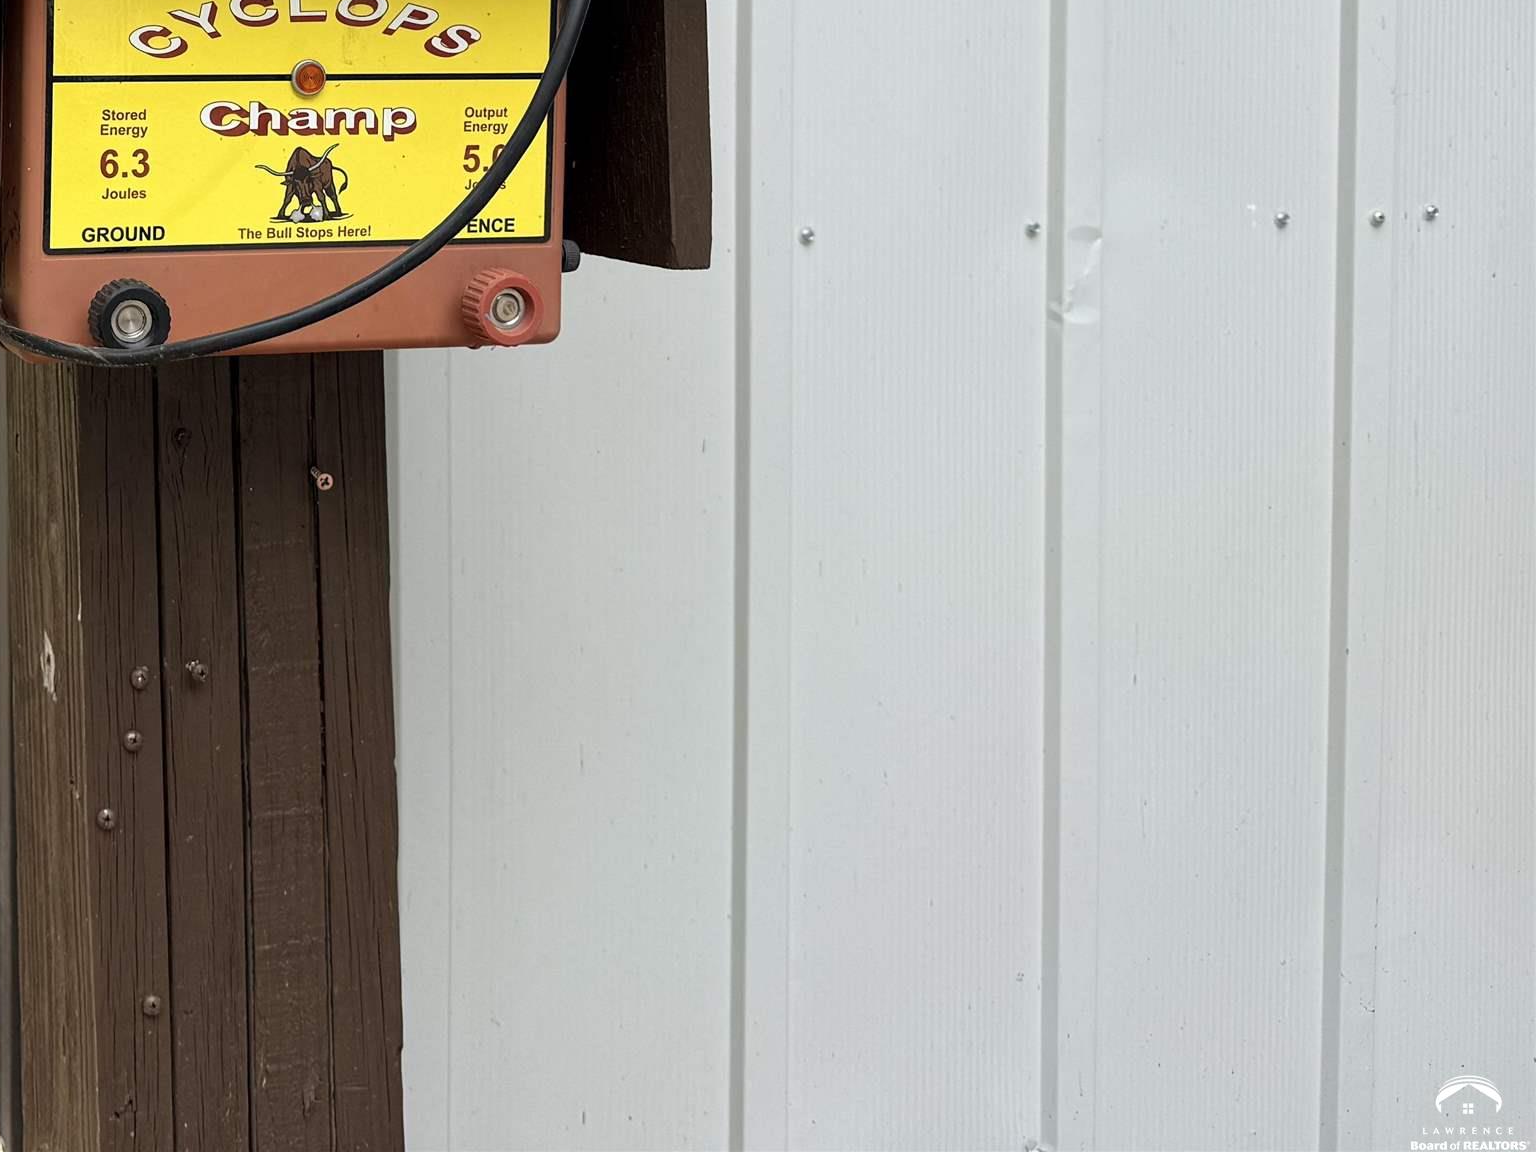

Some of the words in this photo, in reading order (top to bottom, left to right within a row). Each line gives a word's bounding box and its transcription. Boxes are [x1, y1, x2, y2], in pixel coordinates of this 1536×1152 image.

[101, 109, 147, 121] Stored
[464, 106, 508, 120] Output
[199, 100, 417, 142] Champ
[463, 120, 508, 135] Energy
[100, 124, 148, 138] Energy
[99, 148, 151, 179] 6.3
[101, 188, 147, 200] Joules
[238, 227, 263, 240] The
[266, 227, 292, 239] Bull
[296, 226, 333, 240] Stops
[338, 225, 372, 238] Here!
[464, 218, 515, 233] ENCE
[81, 225, 166, 243] GROUND
